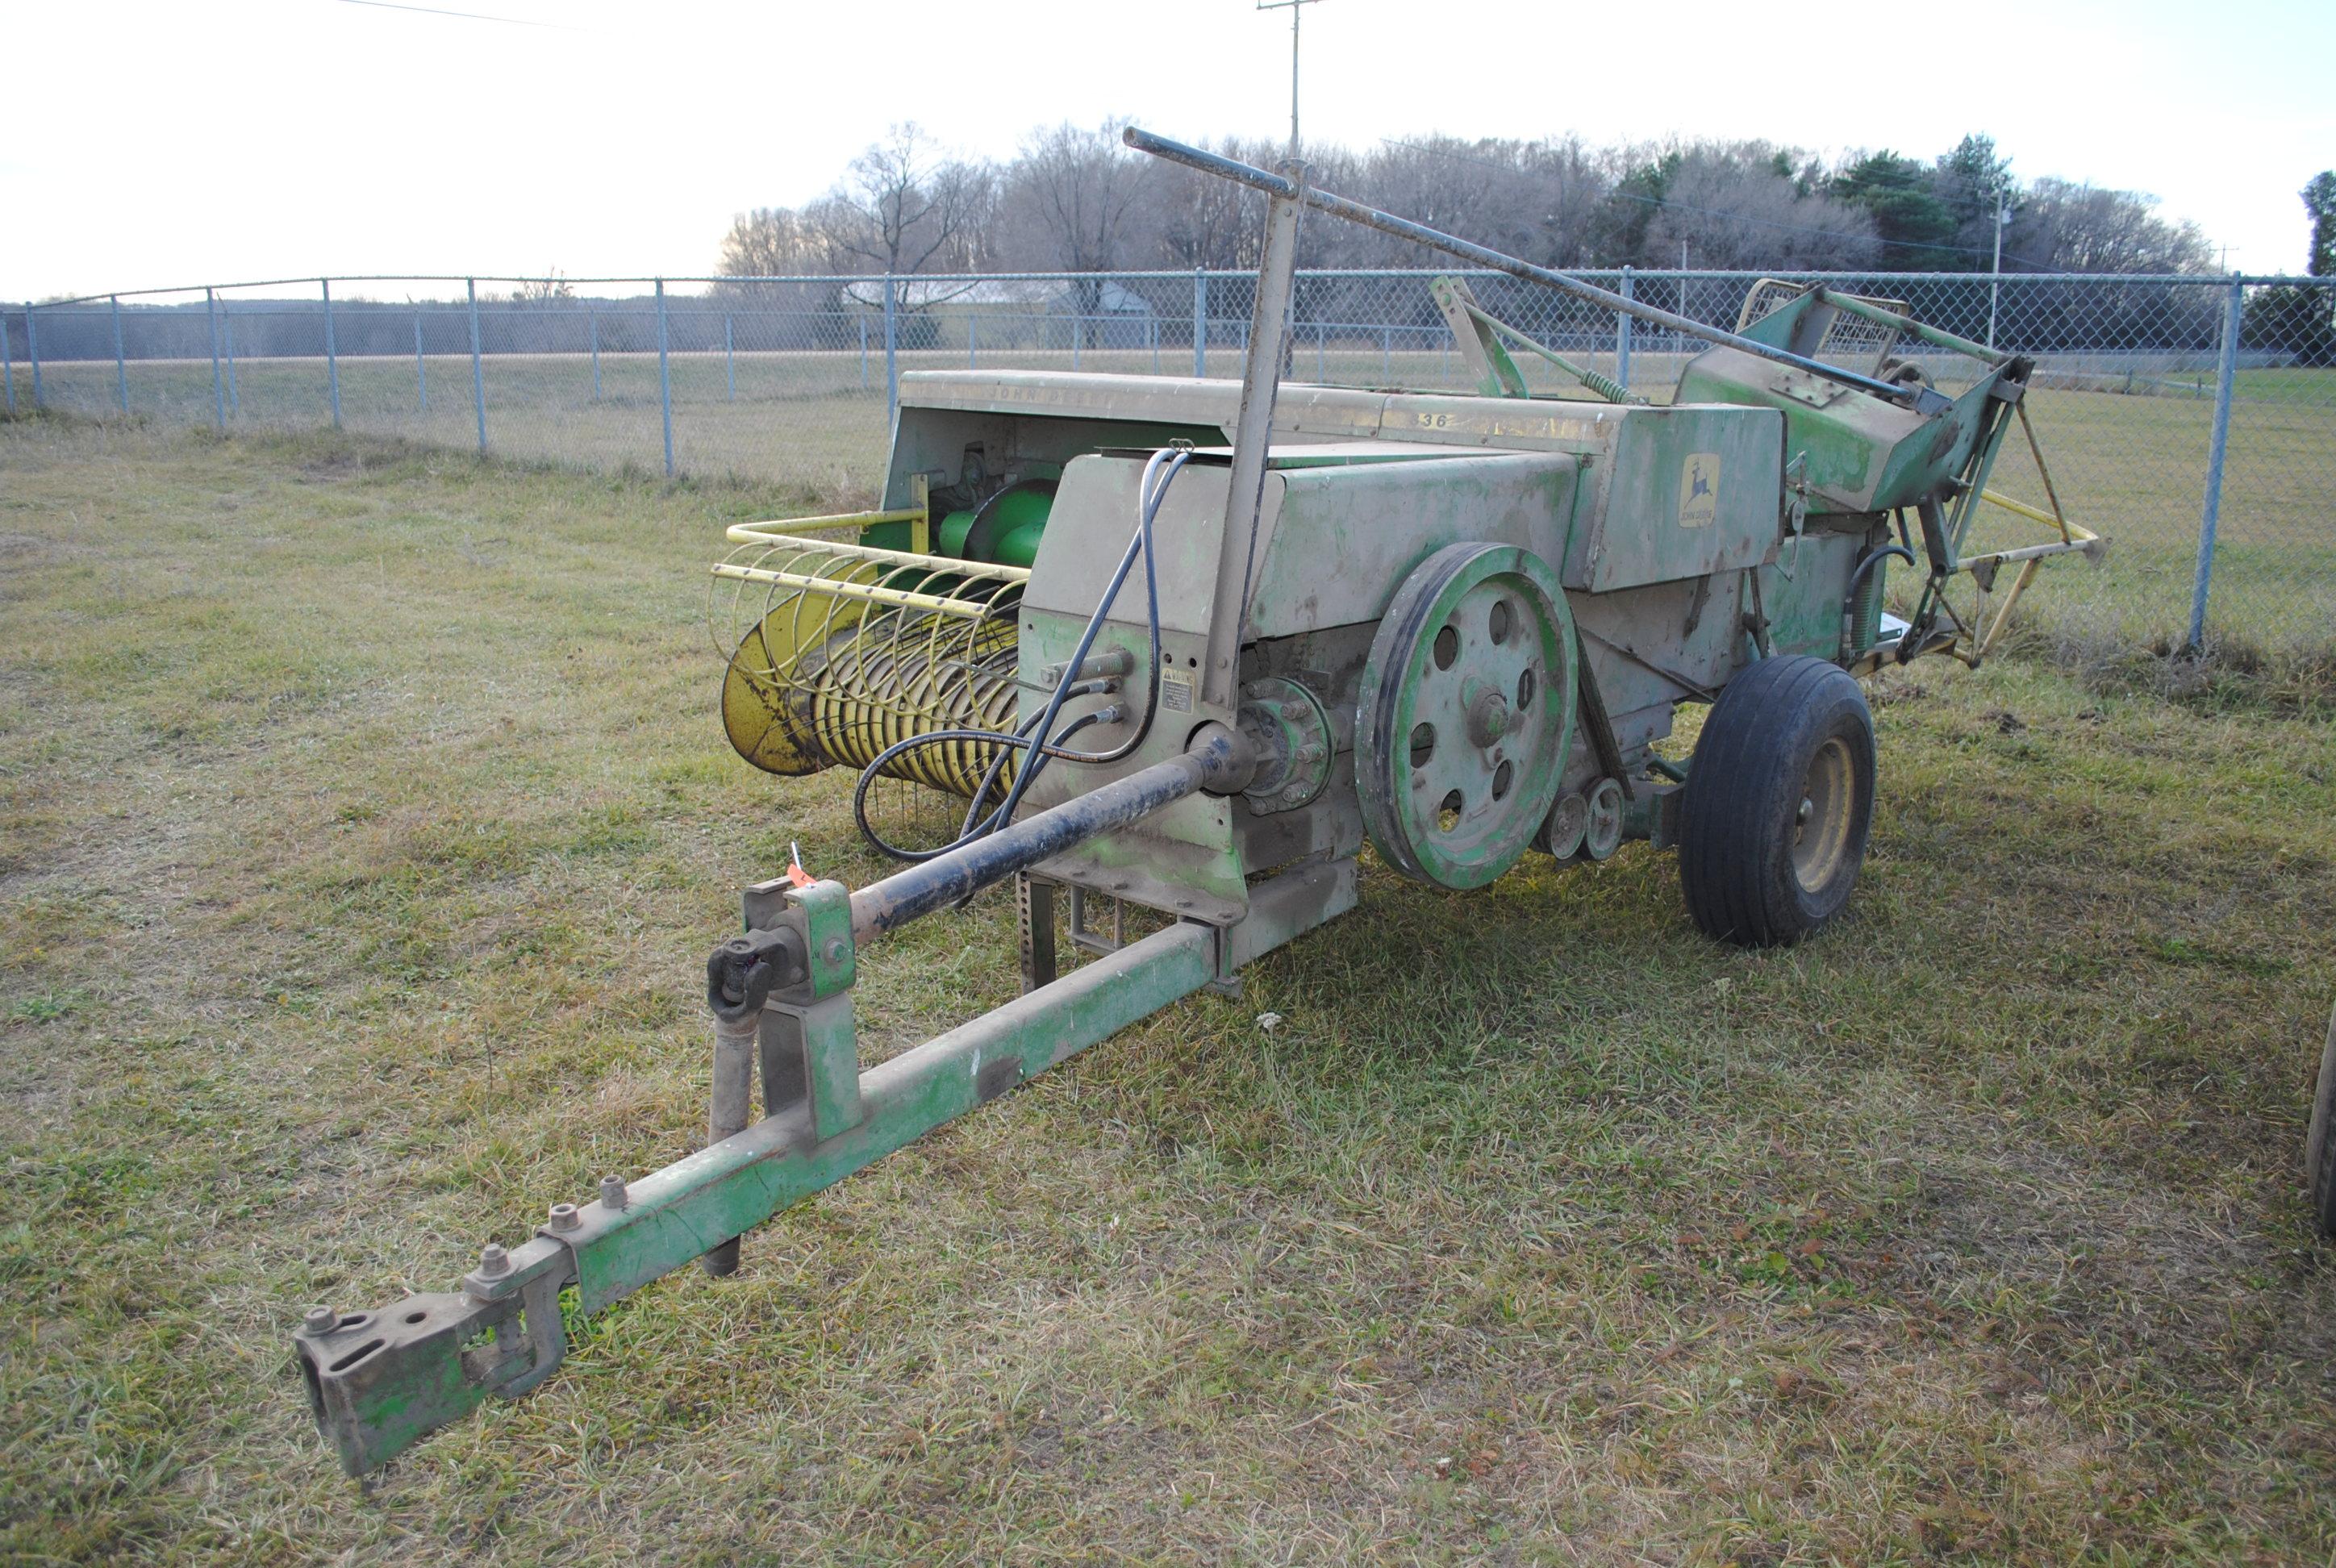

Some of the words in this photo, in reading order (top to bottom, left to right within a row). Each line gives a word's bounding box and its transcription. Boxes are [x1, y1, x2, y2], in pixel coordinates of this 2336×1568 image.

[990, 388, 1037, 401] JOHN
[1681, 511, 1695, 521] JOHN
[1696, 510, 1712, 520] DEERE
